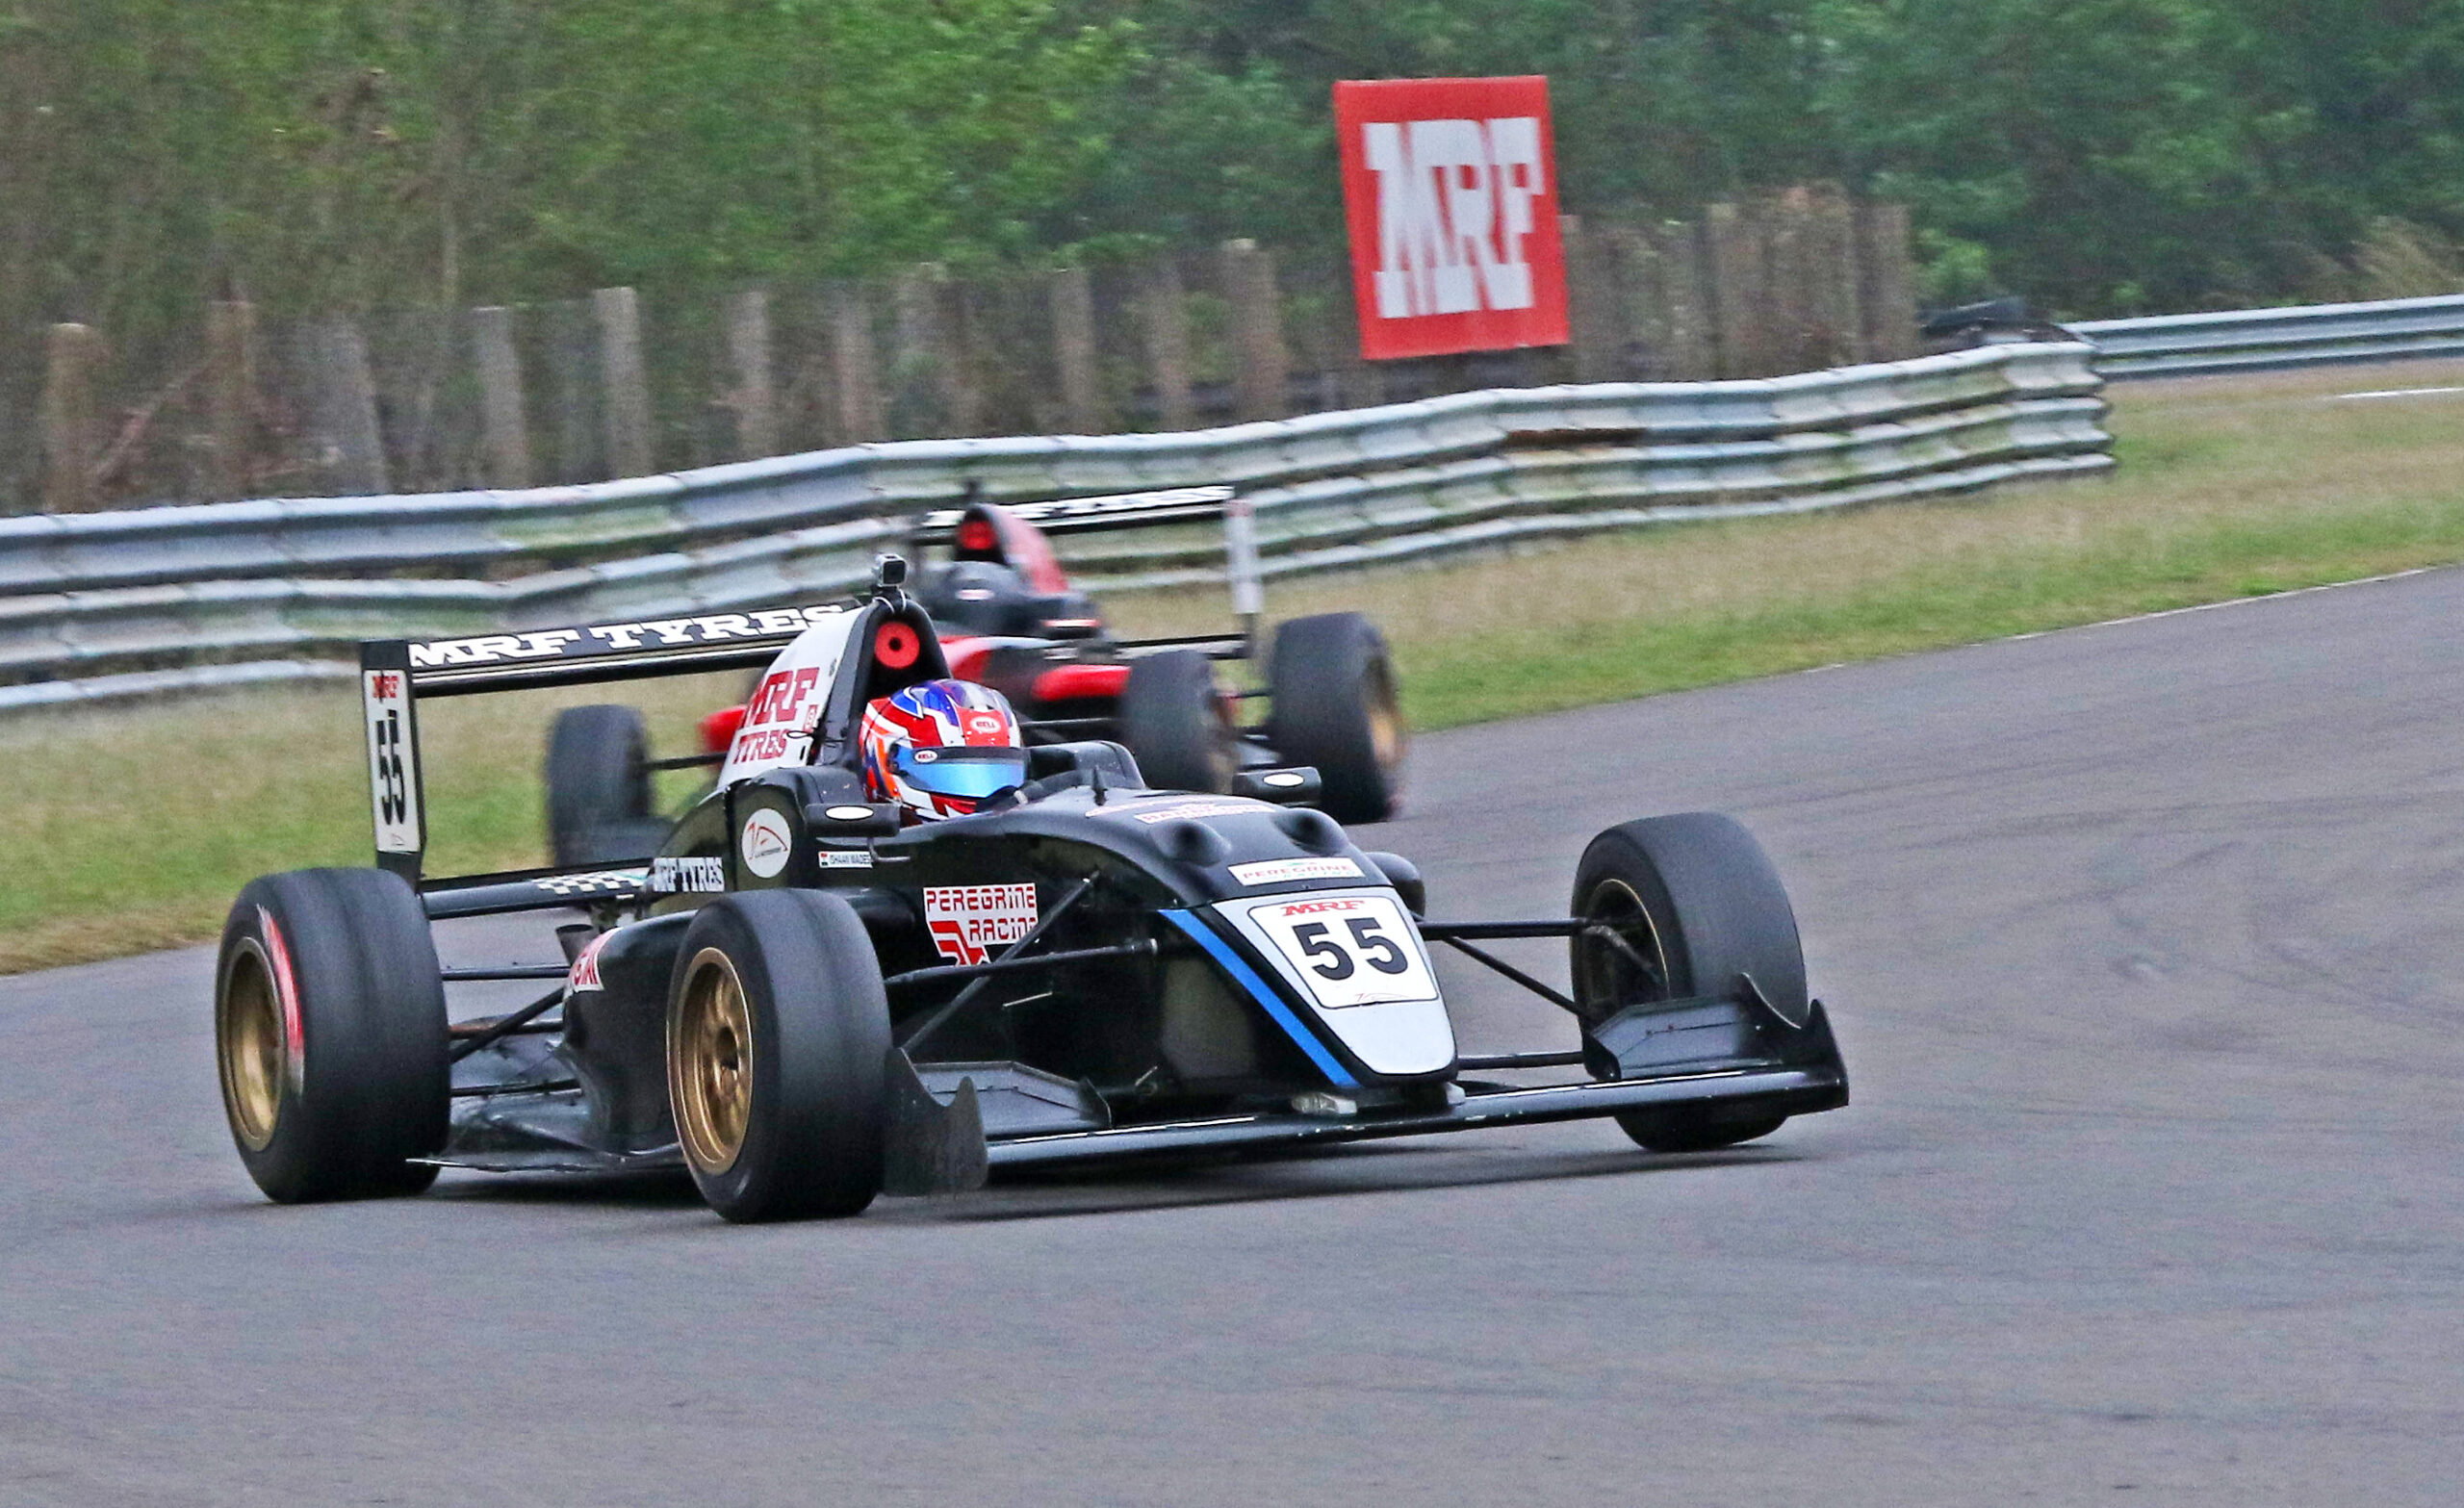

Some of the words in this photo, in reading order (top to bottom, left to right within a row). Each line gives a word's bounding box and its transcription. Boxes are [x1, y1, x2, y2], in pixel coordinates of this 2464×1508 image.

[1361, 116, 1545, 319] MRF
[407, 628, 580, 668] MRF
[588, 604, 845, 650] TYRES
[976, 721, 996, 729] BELL
[375, 708, 406, 826] 55
[678, 856, 725, 893] TYRES
[1243, 864, 1353, 879] PEREGRINE
[925, 885, 1037, 912] PEREGRINE
[1279, 900, 1366, 917] MRF
[1292, 917, 1409, 982] 55
